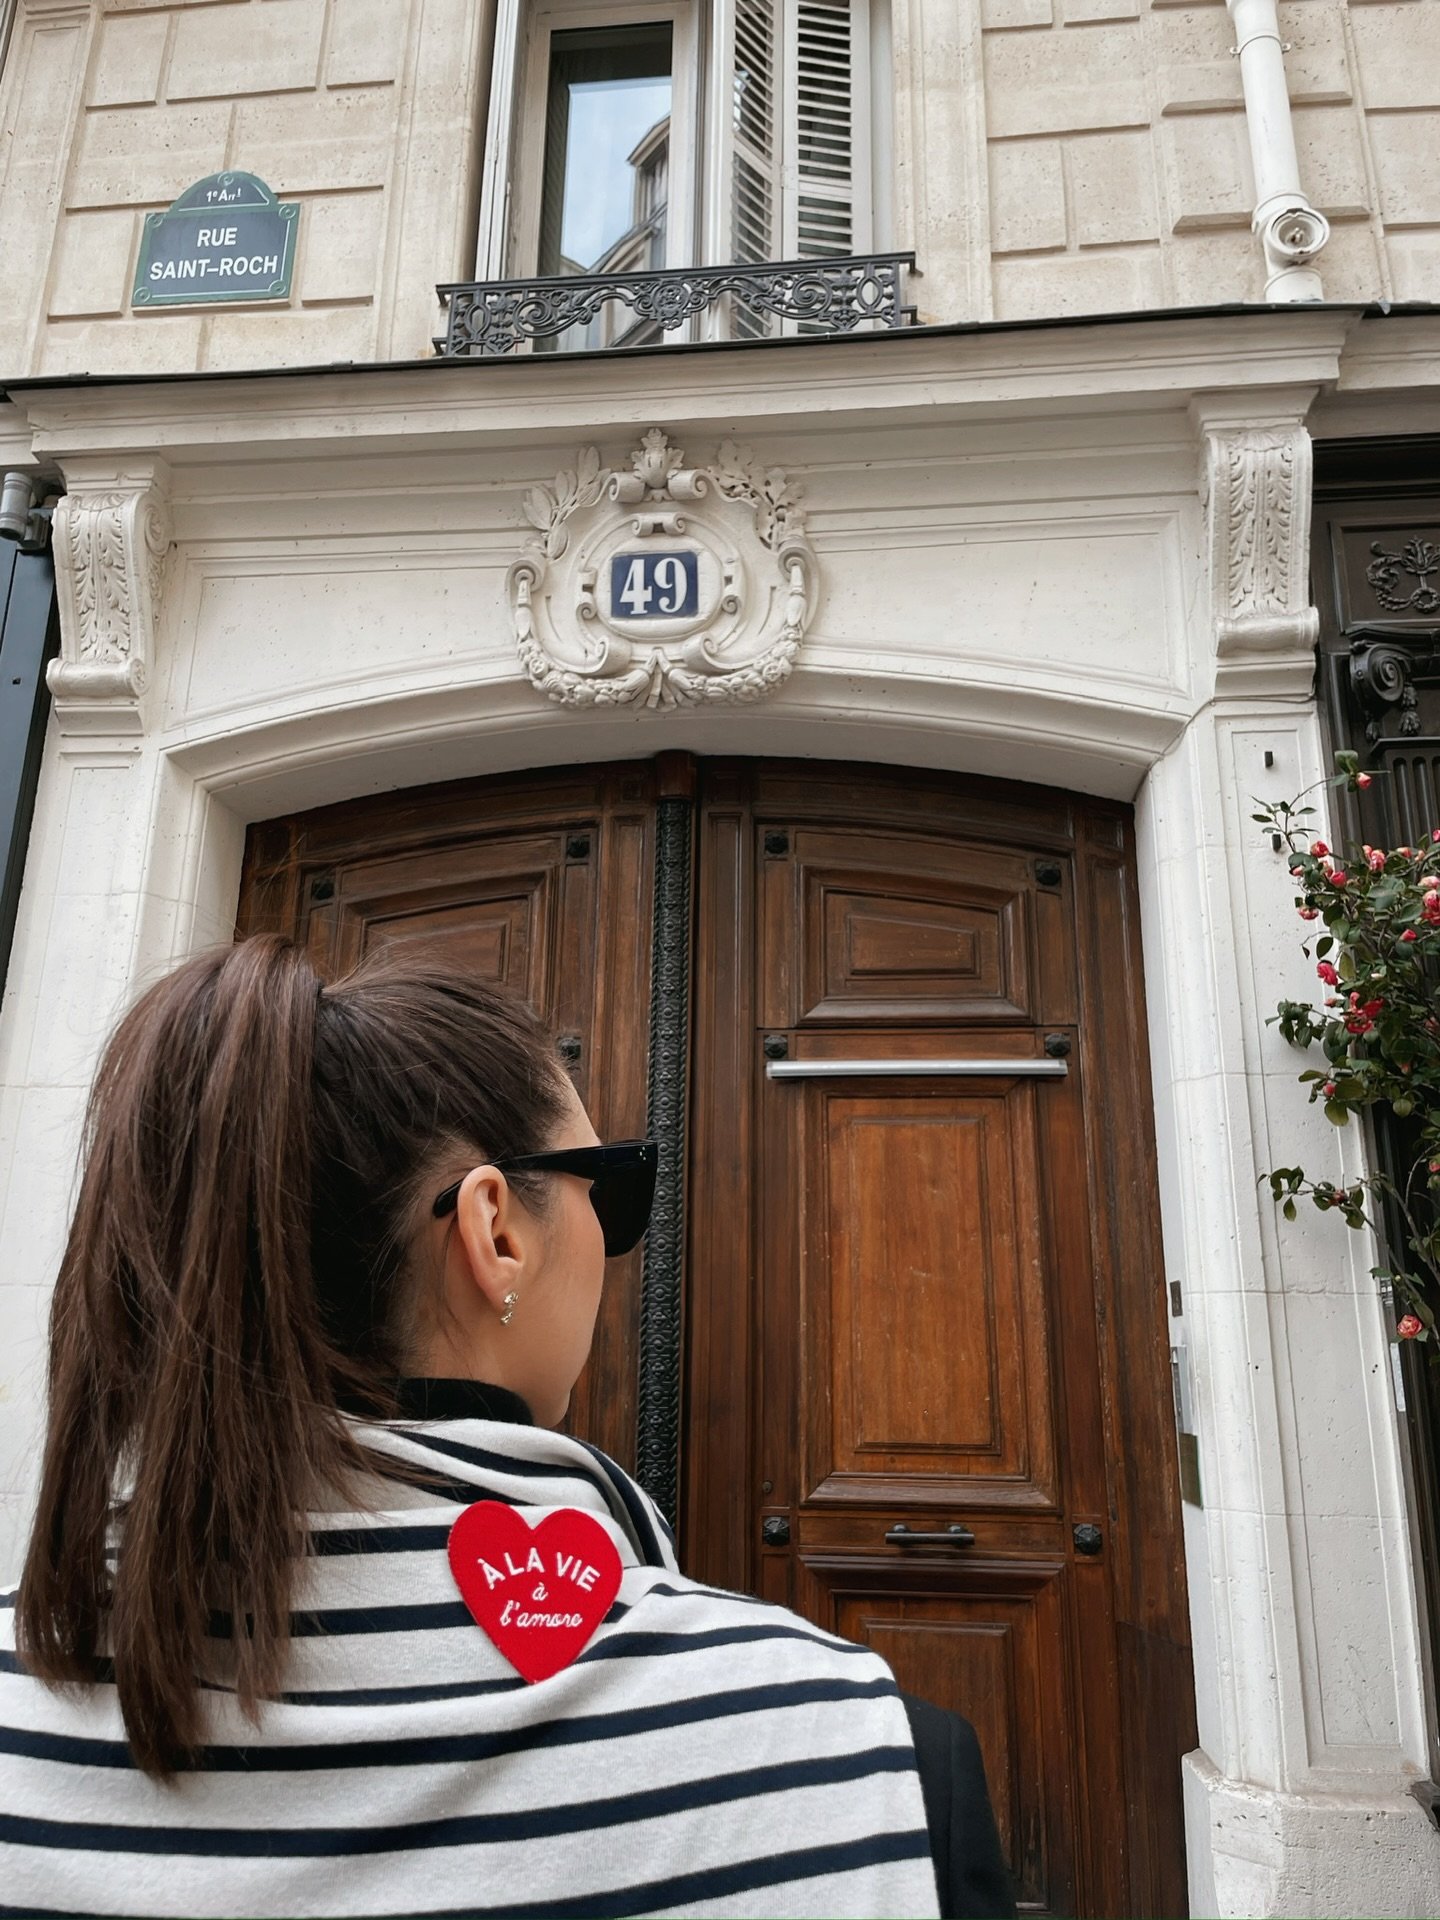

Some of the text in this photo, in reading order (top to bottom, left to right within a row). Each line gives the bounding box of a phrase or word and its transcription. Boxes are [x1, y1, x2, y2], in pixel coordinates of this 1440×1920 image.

[197, 227, 238, 247] RUE
[150, 255, 278, 280] SAINT-ROCH
[619, 557, 687, 615] 49
[477, 1547, 601, 1592] À LA VIE
[532, 1582, 549, 1601] à
[500, 1600, 583, 1627] l'amore
